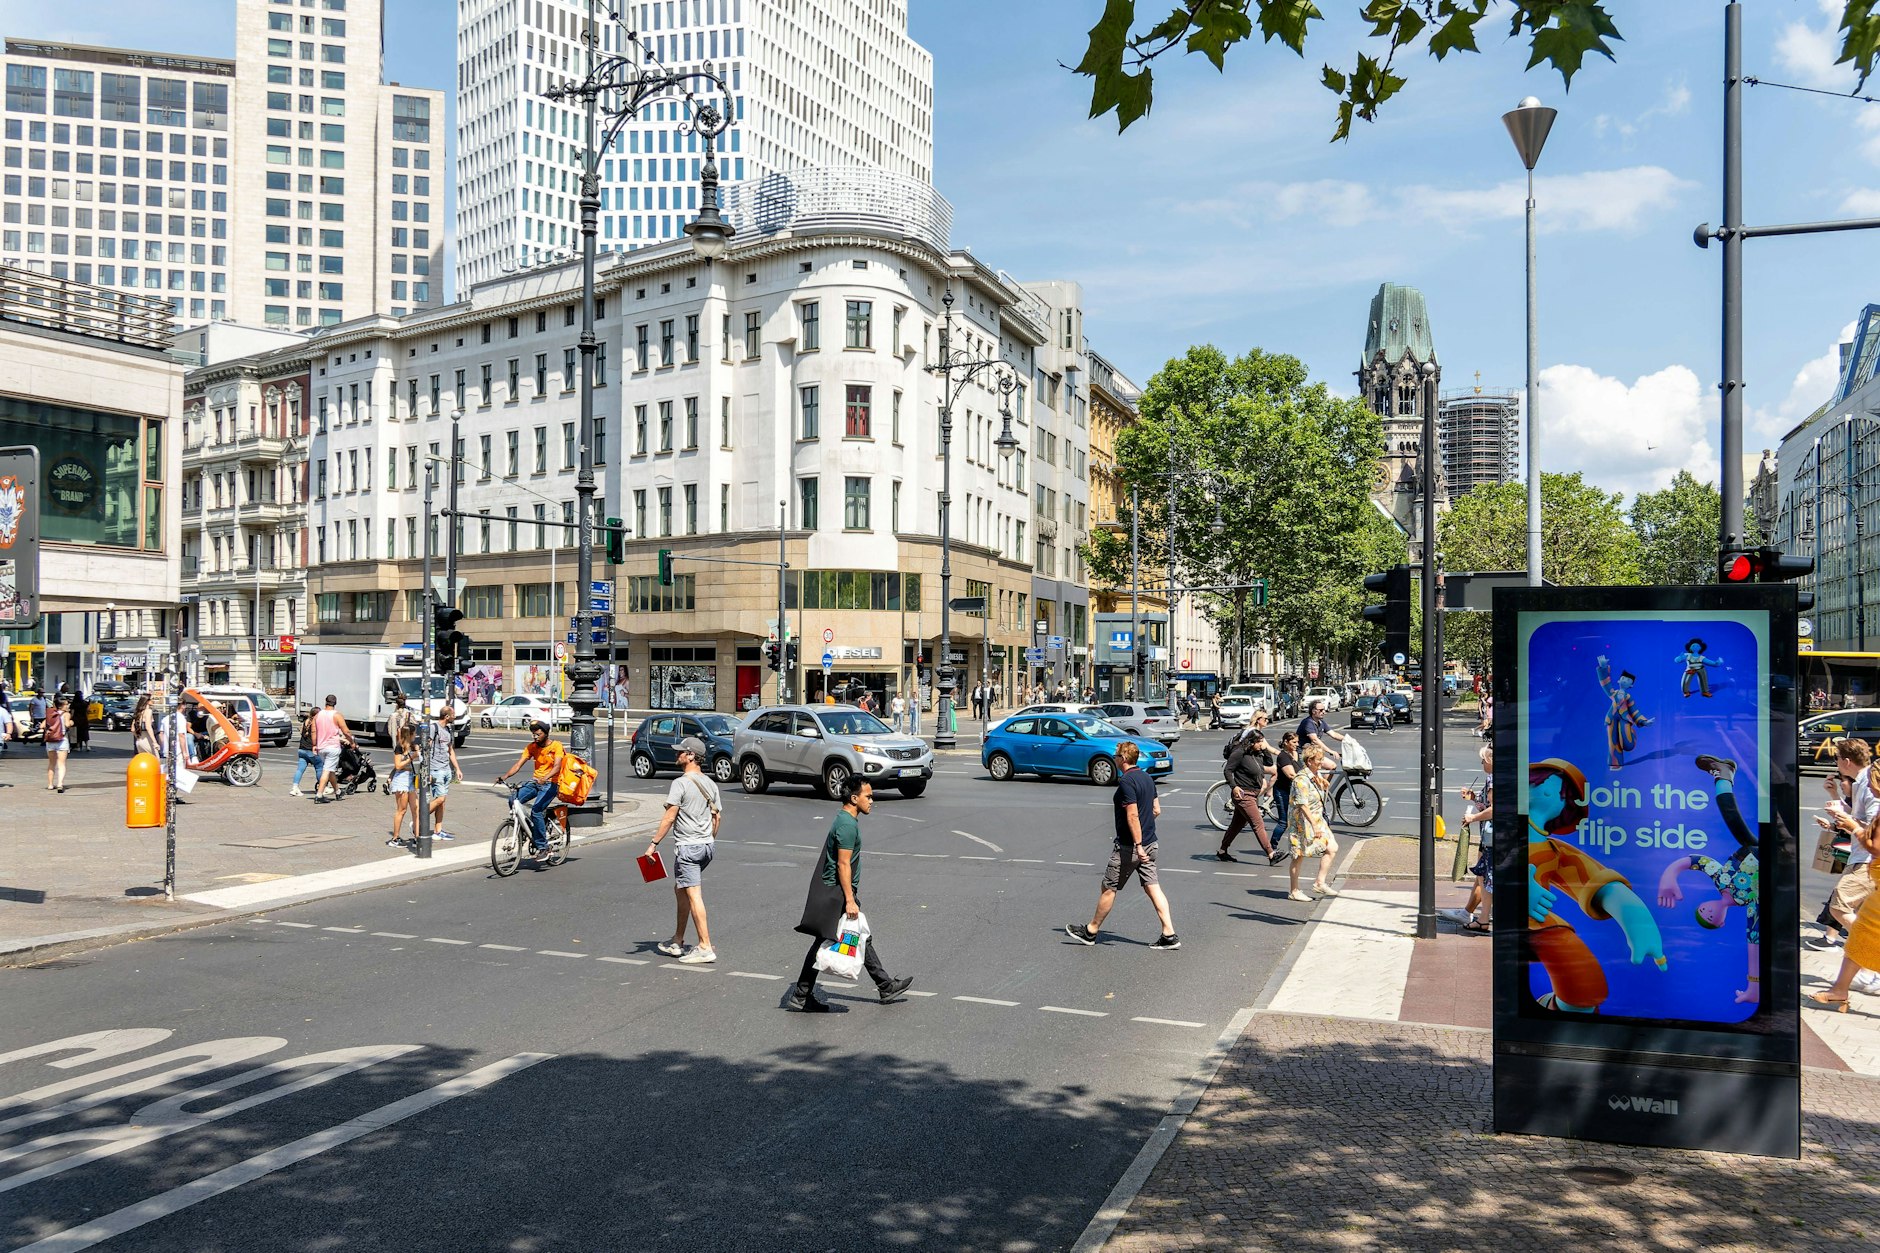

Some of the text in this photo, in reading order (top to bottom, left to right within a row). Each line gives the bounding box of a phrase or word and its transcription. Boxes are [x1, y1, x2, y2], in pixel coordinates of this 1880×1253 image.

[53, 463, 92, 481] SUPERDRY
[60, 490, 84, 502] BRAND
[826, 648, 879, 658] DIESEL
[949, 653, 964, 661] DIESEL
[1574, 780, 1710, 811] Join the
[1575, 817, 1709, 855] flip side
[1630, 1096, 1679, 1115] Wall
